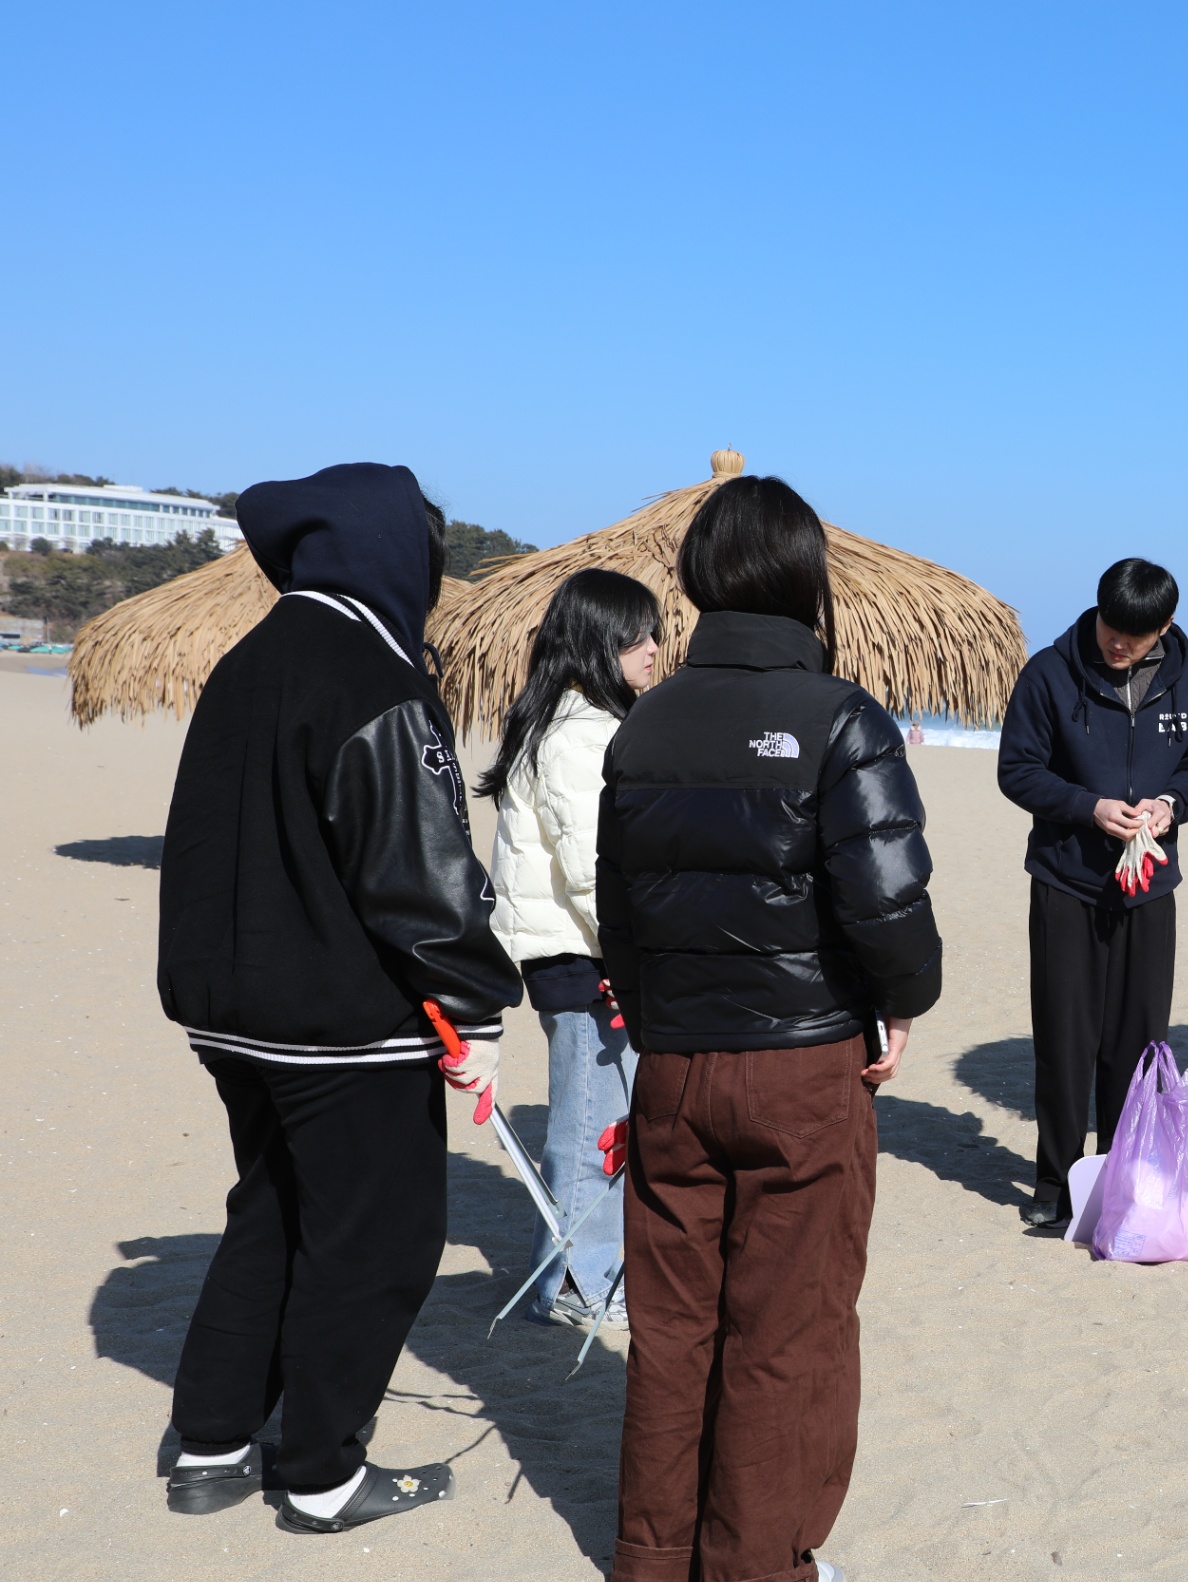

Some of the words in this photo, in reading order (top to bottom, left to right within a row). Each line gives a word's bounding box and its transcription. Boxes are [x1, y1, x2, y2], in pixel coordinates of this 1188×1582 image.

[763, 731, 783, 741] THE
[748, 739, 783, 749] NORTH
[757, 748, 781, 757] FACE
